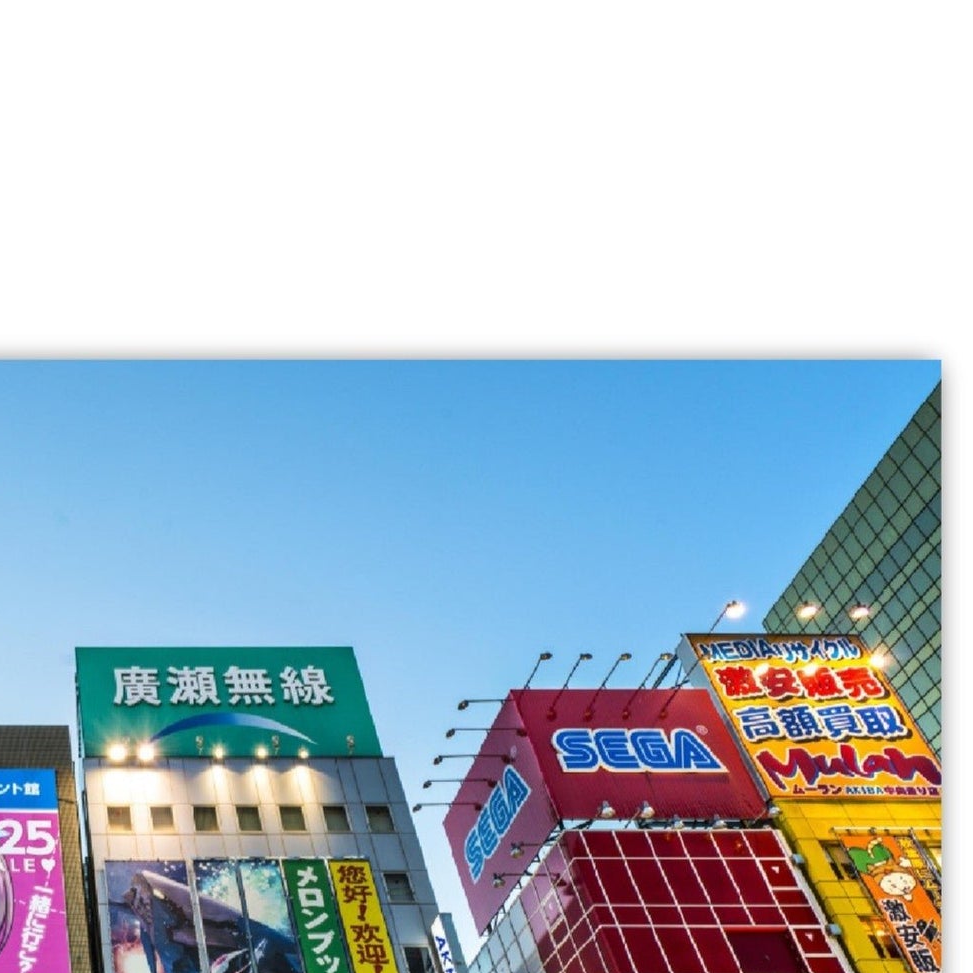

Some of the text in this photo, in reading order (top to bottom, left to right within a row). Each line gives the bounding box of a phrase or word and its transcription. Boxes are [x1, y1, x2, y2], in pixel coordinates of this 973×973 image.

[114, 666, 334, 706] 廣瀬無線
[715, 666, 884, 698] 激安販売
[733, 704, 907, 741] 高額買取
[551, 728, 729, 773] SEGA
[756, 744, 941, 790] Mulan
[792, 785, 841, 795] ムーラン
[464, 765, 531, 884] SEGA
